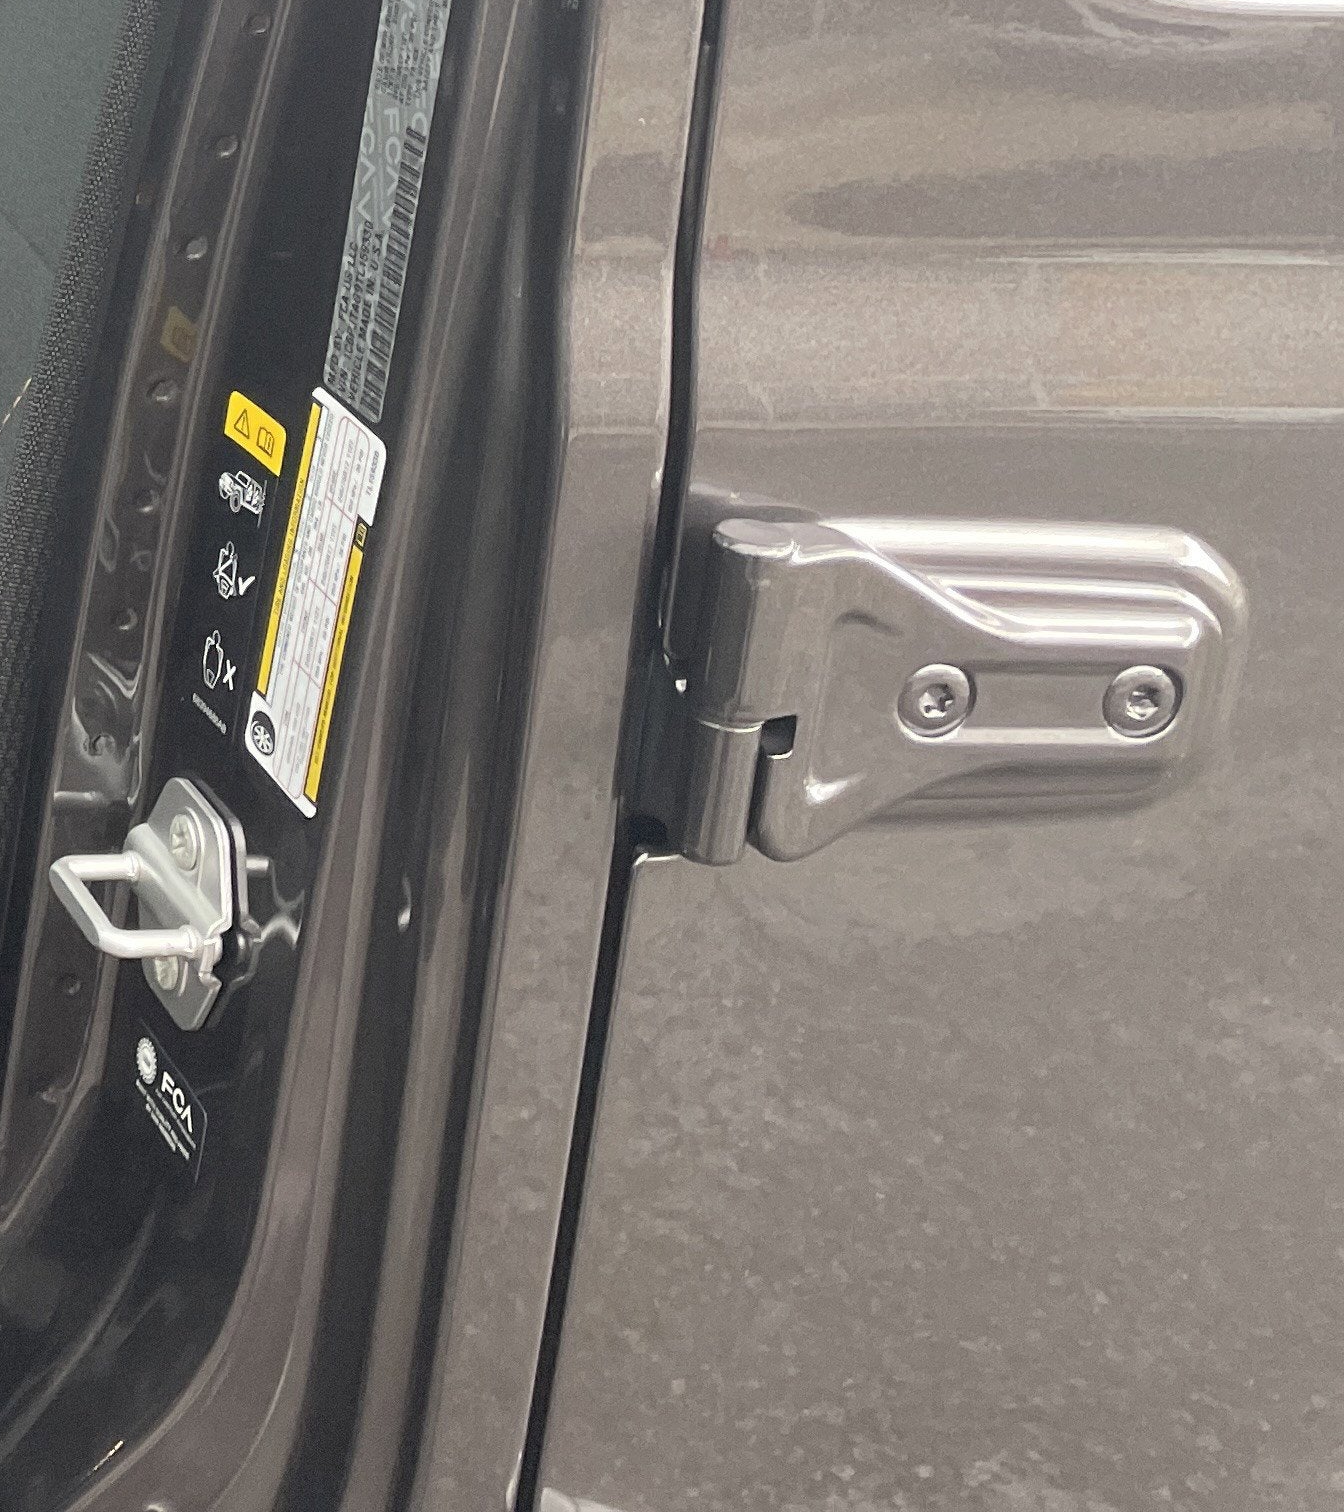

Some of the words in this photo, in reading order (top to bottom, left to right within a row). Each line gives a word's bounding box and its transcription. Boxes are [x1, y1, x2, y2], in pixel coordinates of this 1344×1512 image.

[348, 341, 365, 404] VEHICLE
[358, 295, 372, 342] MADE
[161, 1071, 193, 1133] FCA
